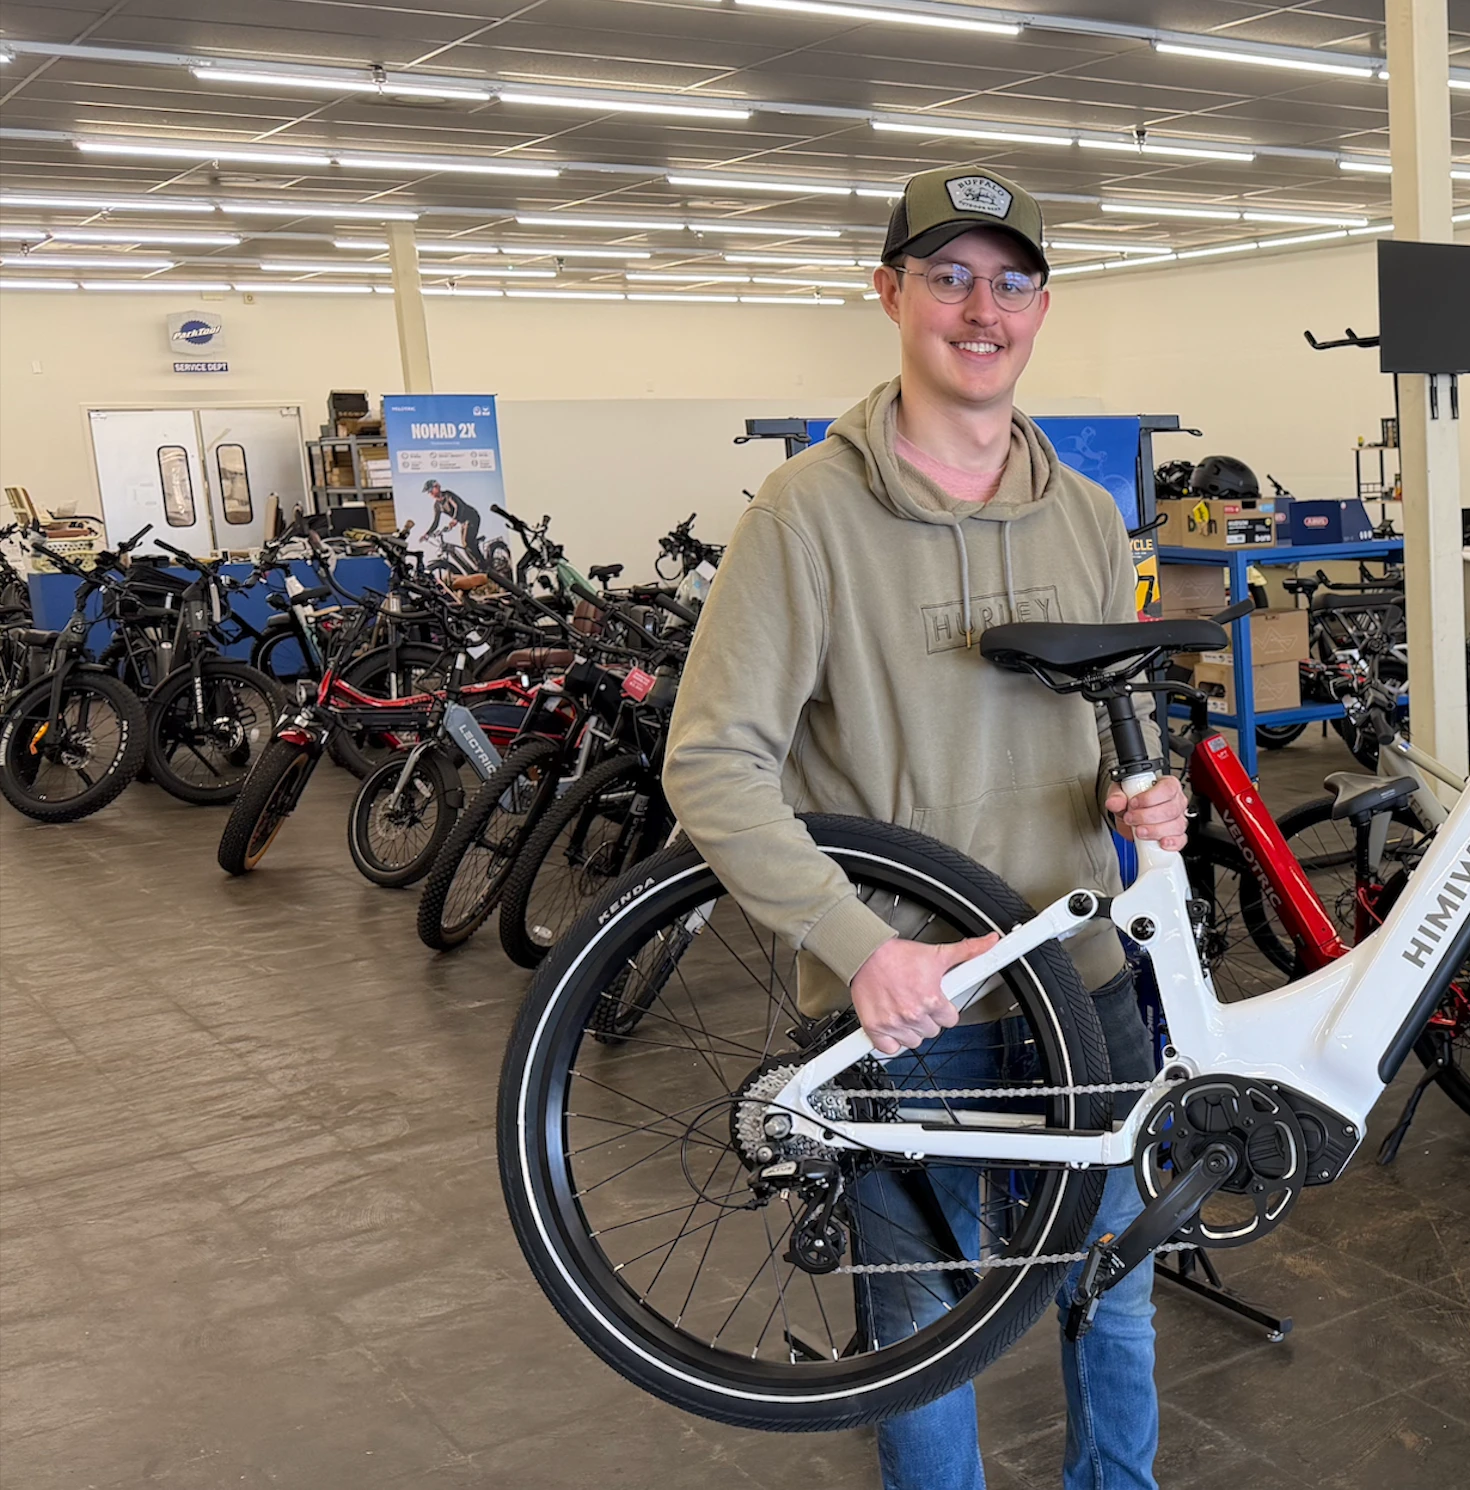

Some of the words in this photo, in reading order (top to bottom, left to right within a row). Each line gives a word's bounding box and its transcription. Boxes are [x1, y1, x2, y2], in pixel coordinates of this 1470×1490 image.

[957, 179, 1004, 196] BUFFALO
[174, 363, 207, 372] SERVICE
[207, 363, 227, 372] DEPT
[411, 423, 456, 439] NOMAD
[459, 423, 477, 438] 2X
[458, 724, 497, 774] LECTRIC
[1221, 808, 1283, 909] VELOTRIC
[598, 877, 656, 925] KENDA
